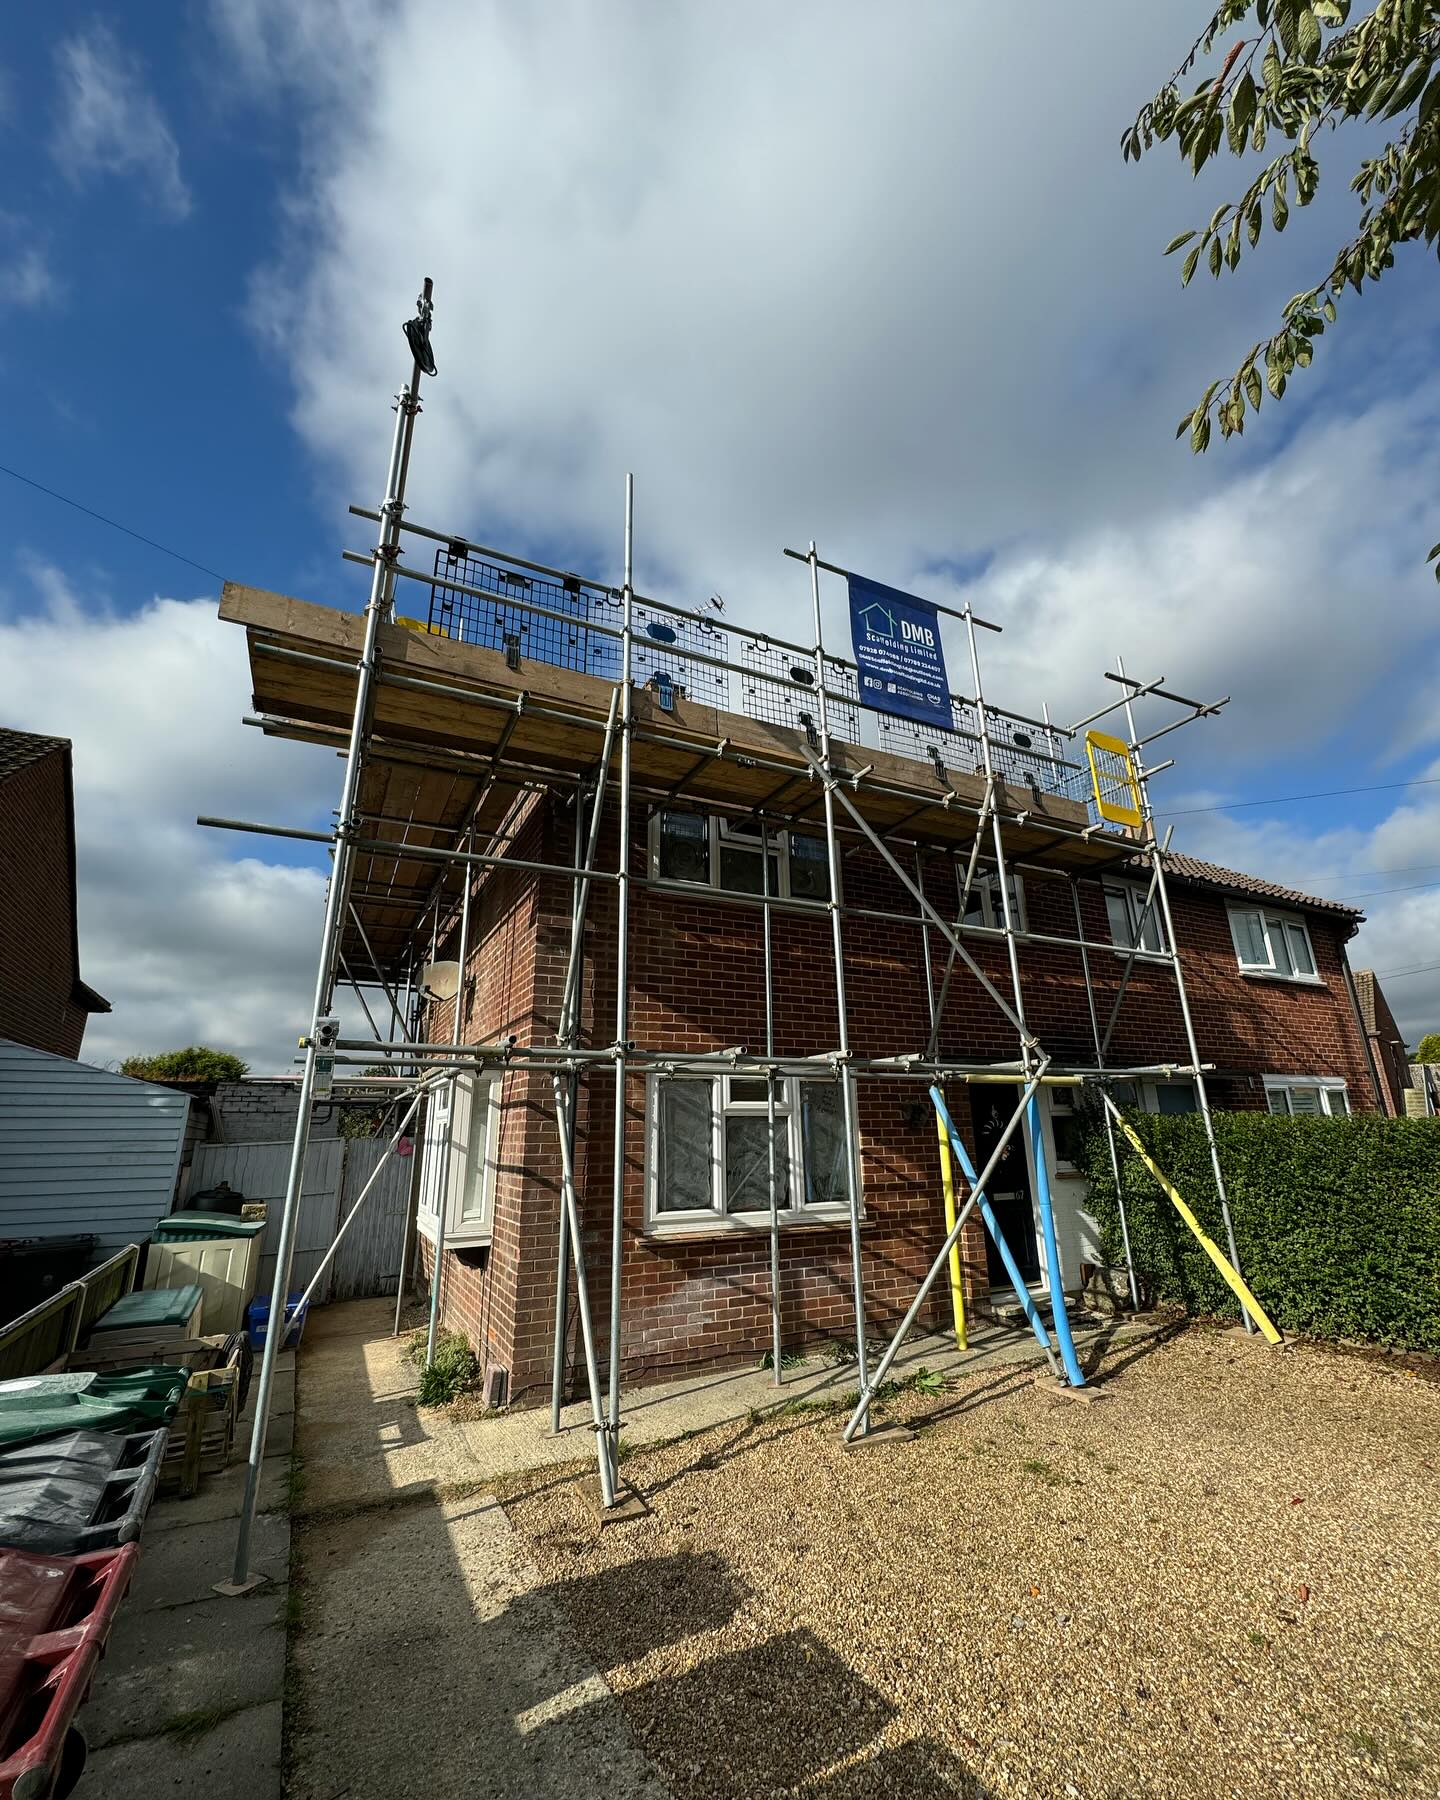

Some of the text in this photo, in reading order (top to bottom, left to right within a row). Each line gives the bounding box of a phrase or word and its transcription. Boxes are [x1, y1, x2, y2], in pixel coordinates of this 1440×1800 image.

[866, 632, 938, 661] Scaffolding Limited
[901, 620, 935, 647] DMB
